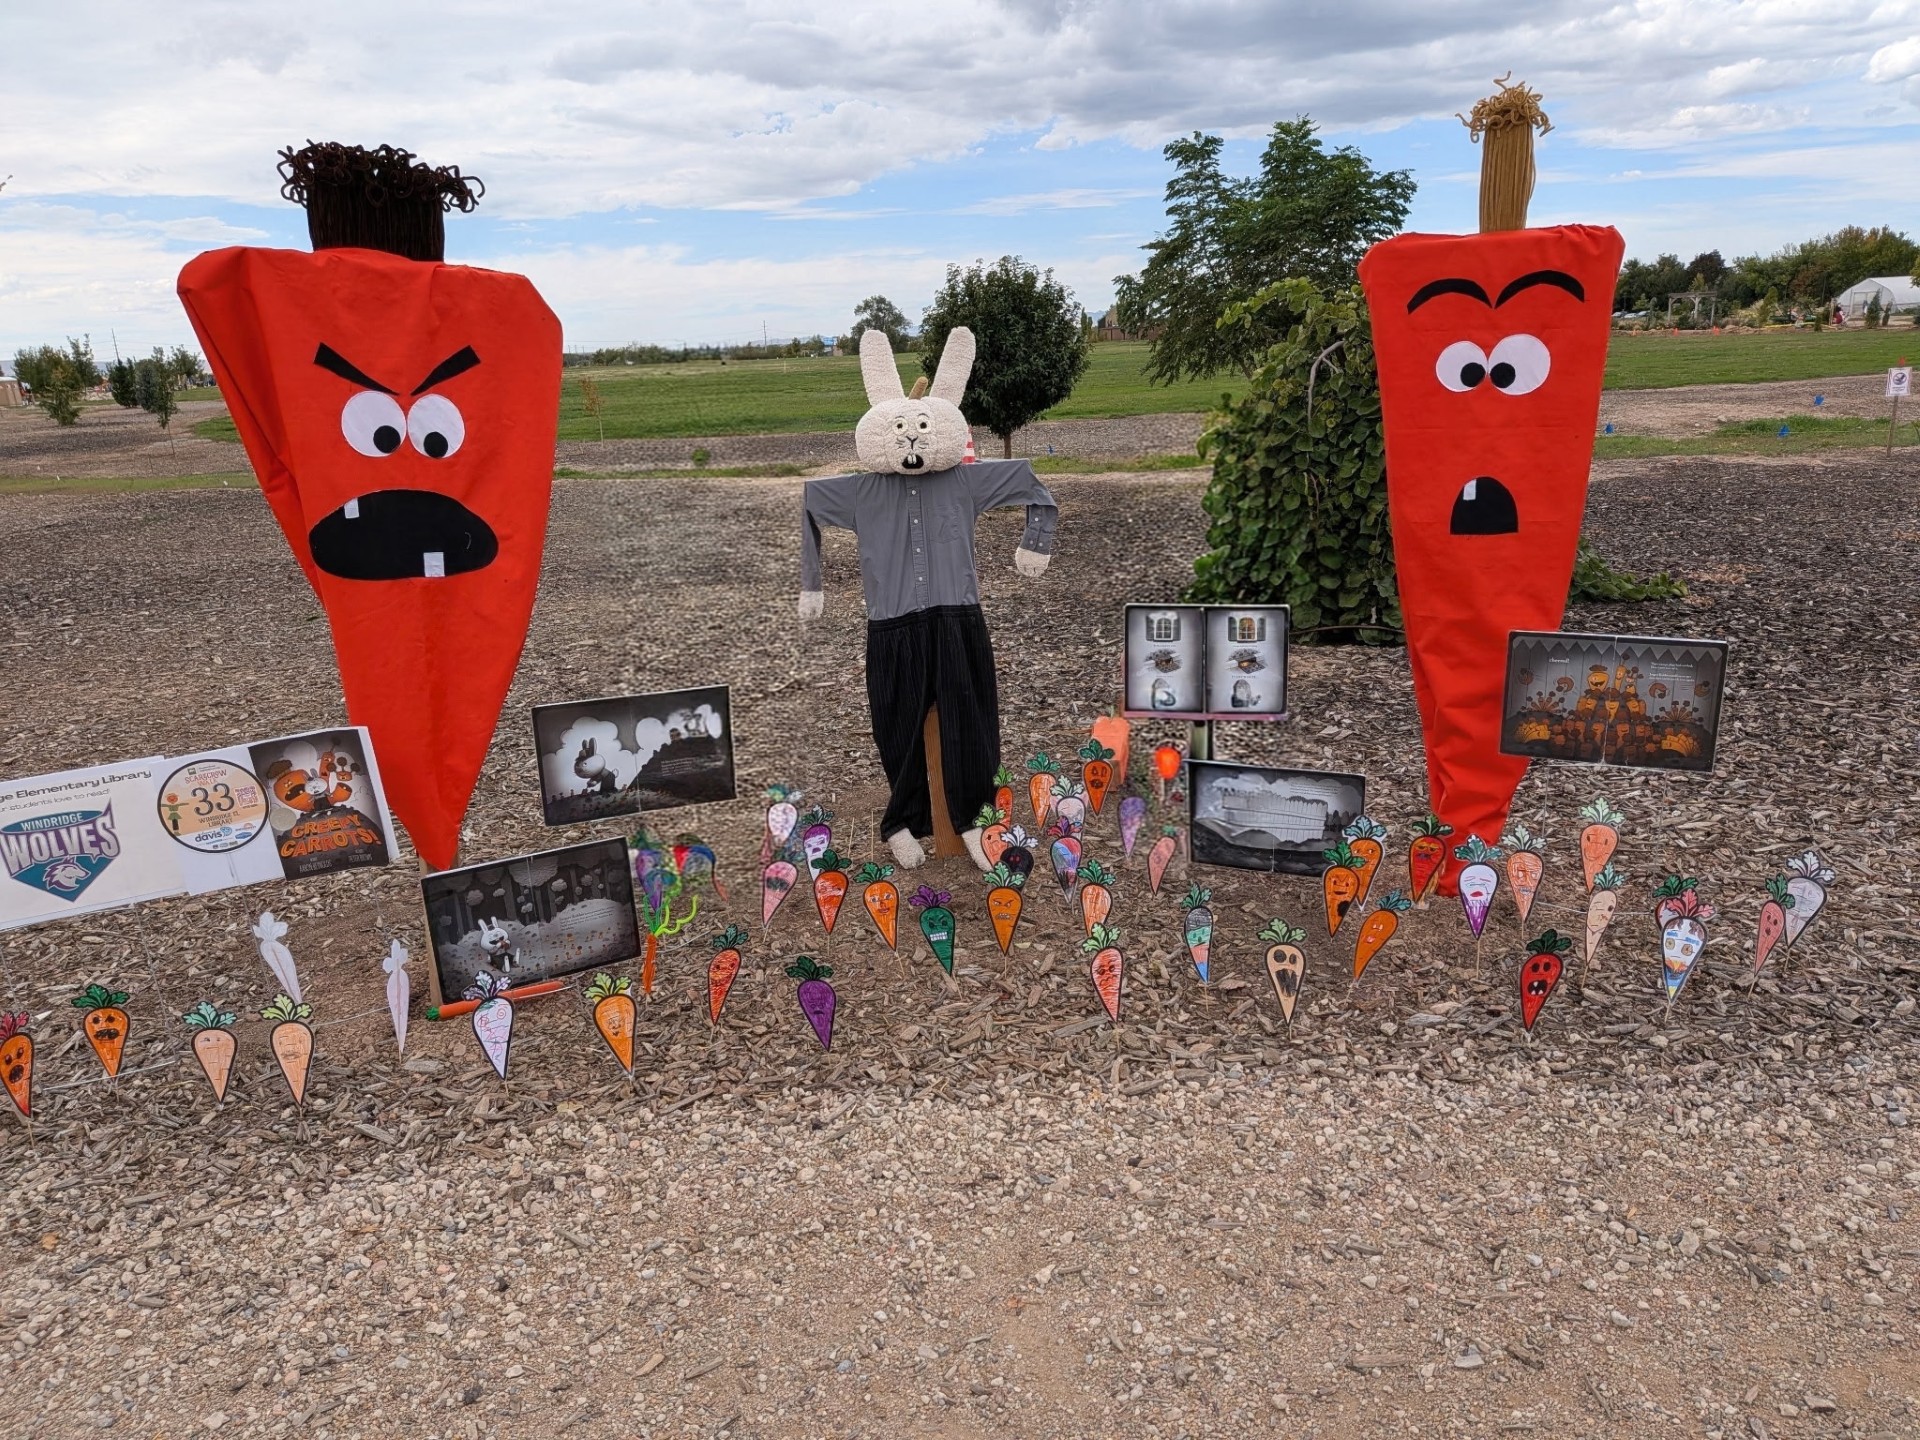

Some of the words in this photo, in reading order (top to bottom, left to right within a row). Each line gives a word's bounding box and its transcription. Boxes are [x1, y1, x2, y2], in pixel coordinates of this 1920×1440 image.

[16, 780, 100, 799] Elementary
[102, 770, 152, 784] Library
[184, 769, 227, 785] SCARECROW
[54, 795, 73, 804] love
[191, 783, 235, 816] 33
[21, 812, 83, 831] WINDRIDGE
[291, 814, 361, 839] CREEPY
[0, 803, 120, 875] WOLVES
[195, 830, 223, 843] davis
[280, 827, 382, 858] CARROTS!
